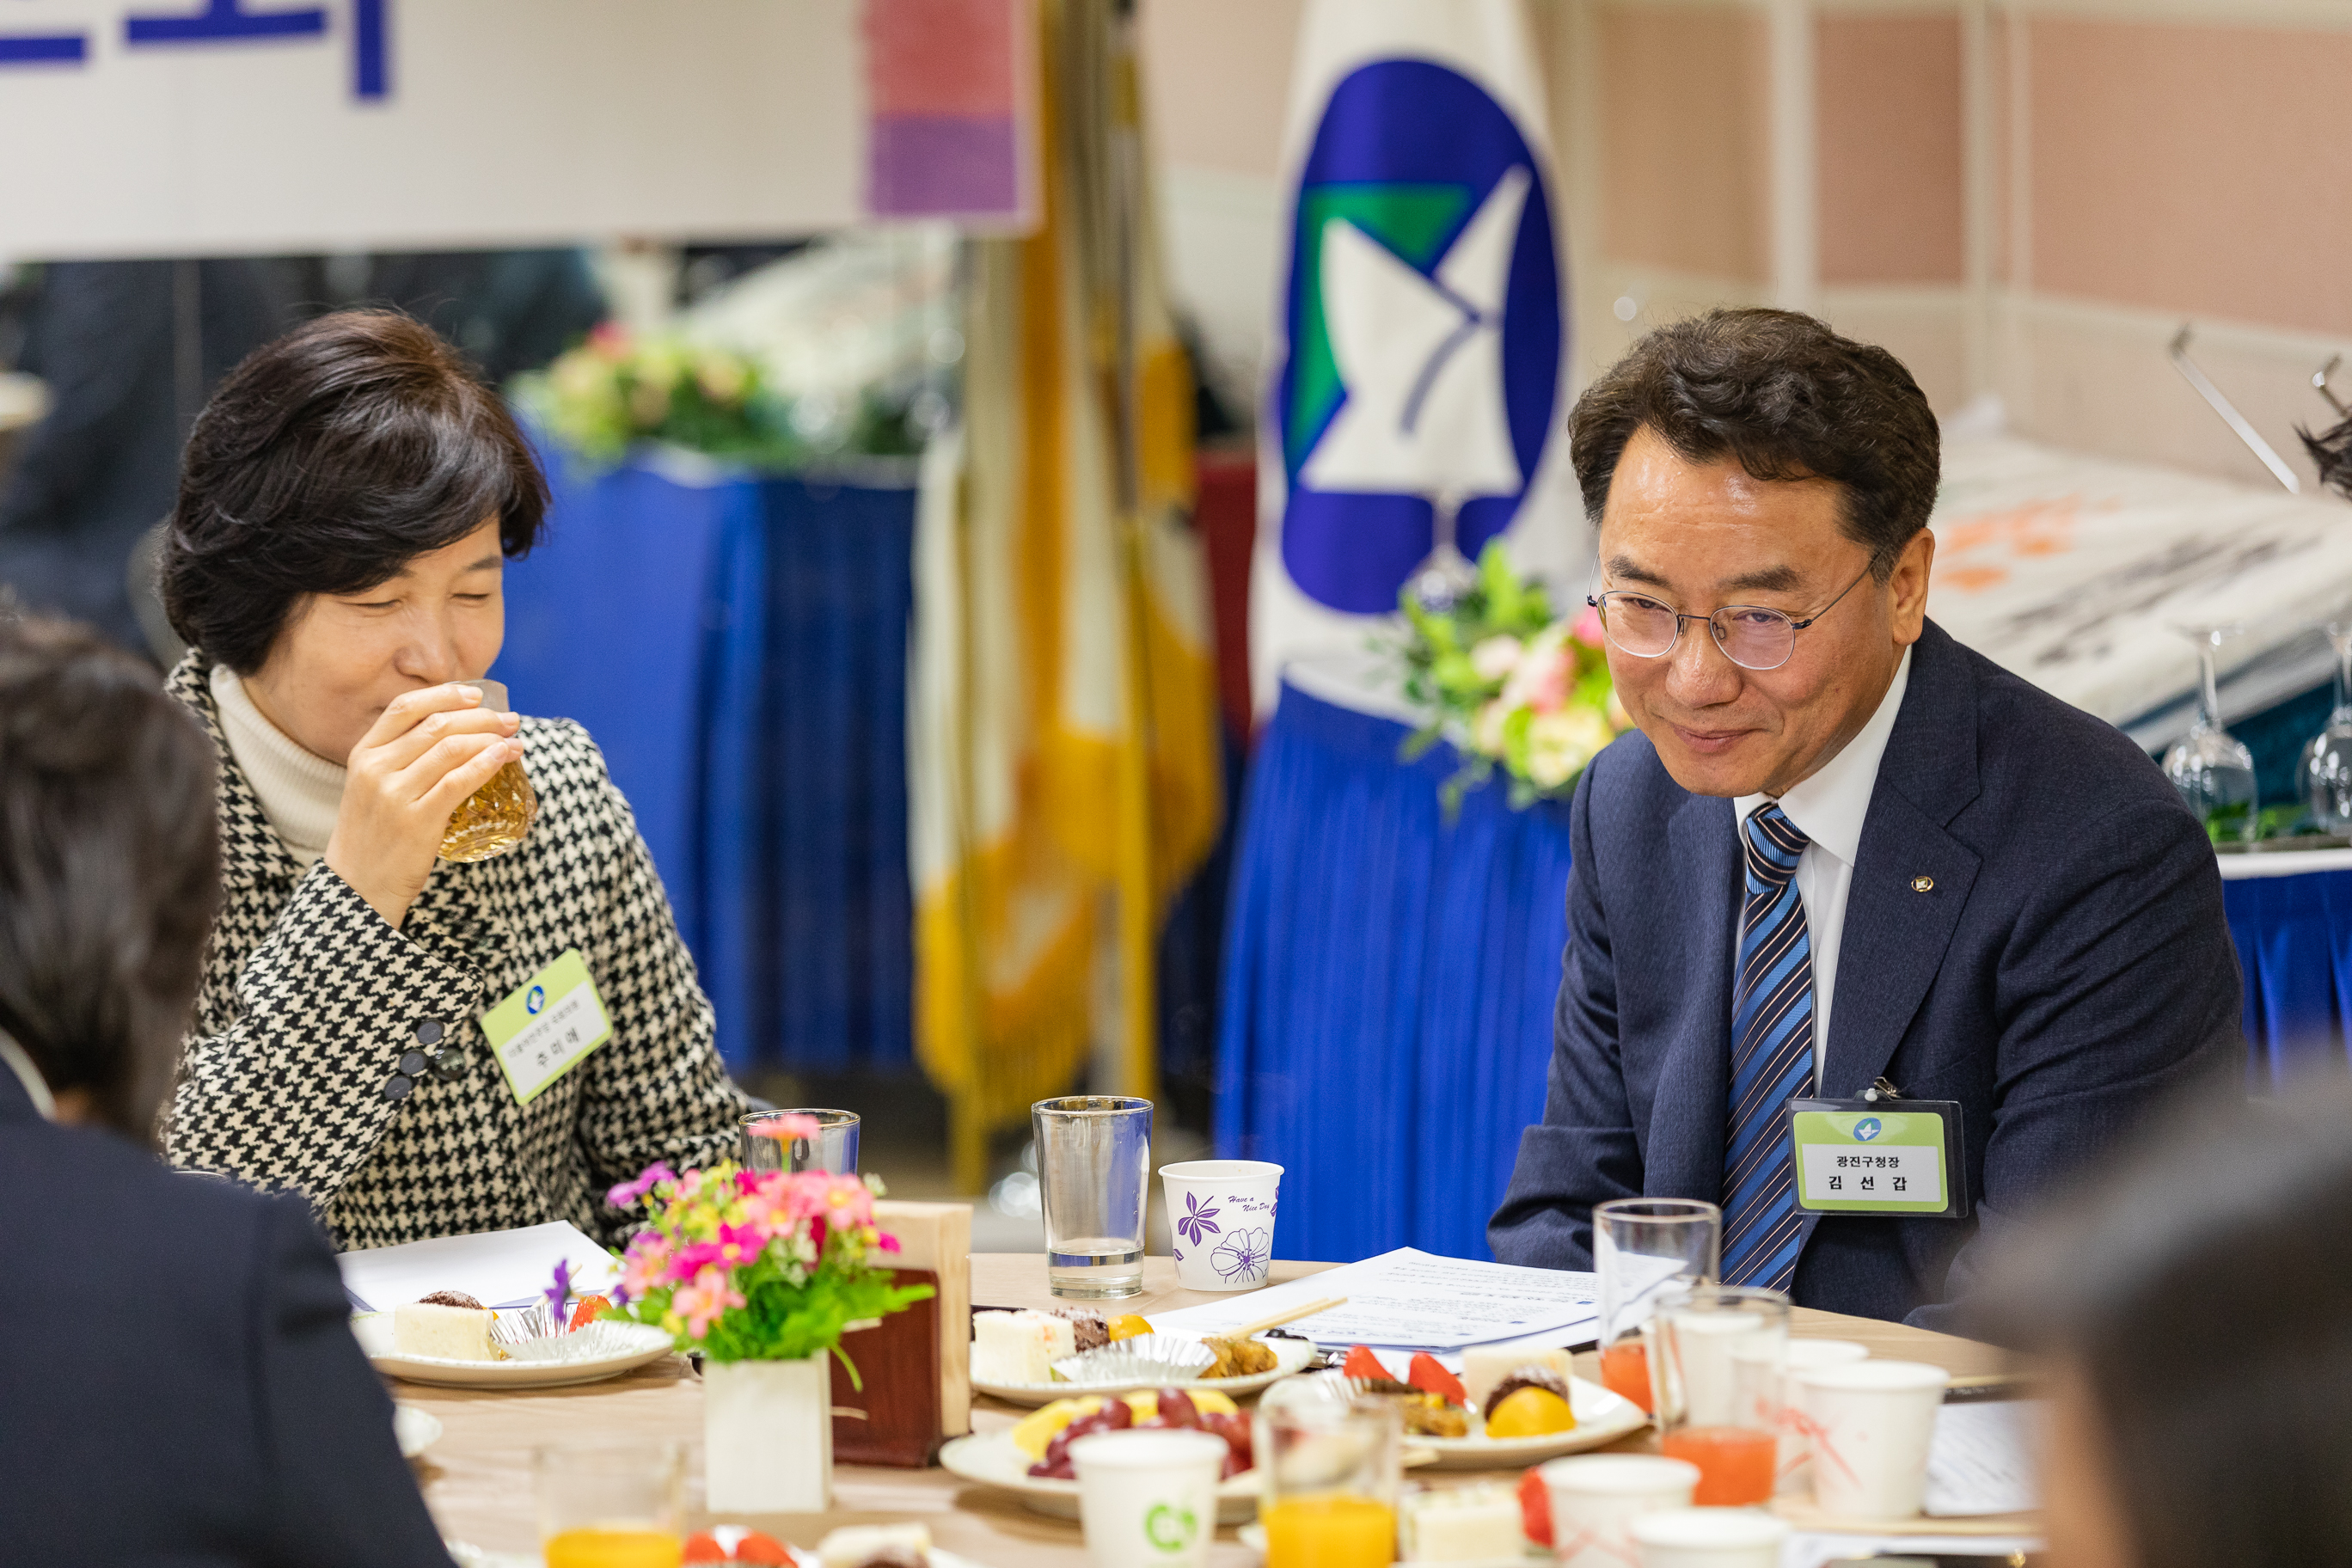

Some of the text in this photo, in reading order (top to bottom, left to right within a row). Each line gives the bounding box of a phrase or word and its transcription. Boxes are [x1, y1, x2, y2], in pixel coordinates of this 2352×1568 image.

[1836, 1155, 1900, 1168] 광진구청장
[1228, 1195, 1247, 1204] Have
[1259, 1202, 1270, 1210] Day
